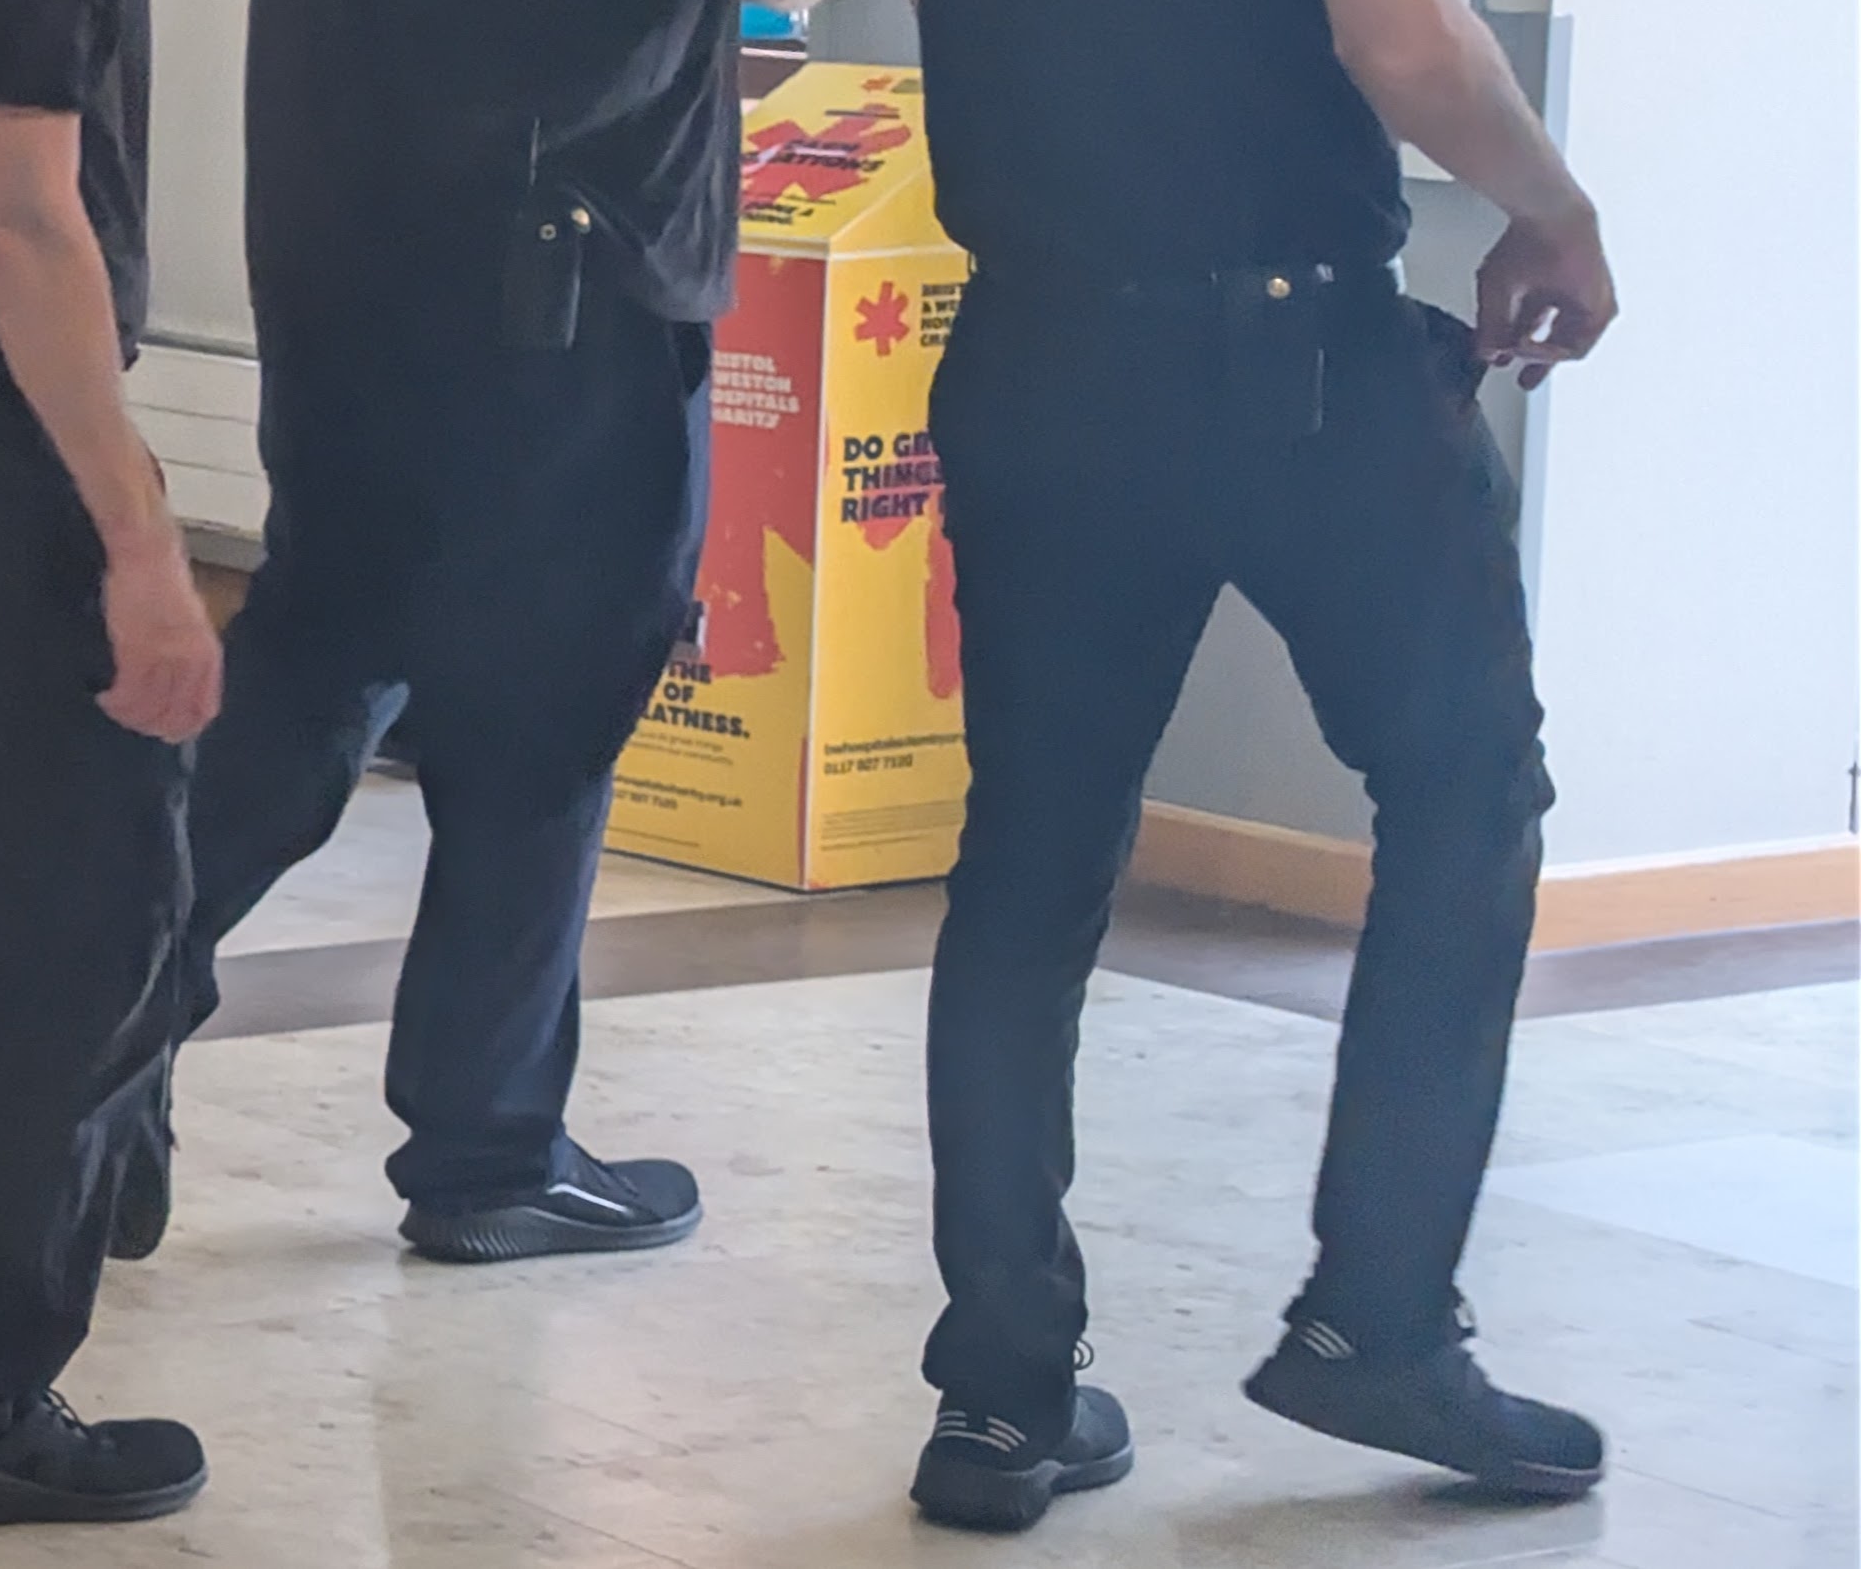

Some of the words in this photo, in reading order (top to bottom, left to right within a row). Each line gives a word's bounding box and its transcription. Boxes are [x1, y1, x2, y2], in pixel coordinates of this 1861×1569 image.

[935, 300, 958, 313] WE
[921, 317, 952, 331] HOS
[710, 389, 801, 413] OSPITALS
[711, 408, 782, 428] HARITY
[842, 434, 884, 462] DO
[893, 431, 934, 458] GR
[841, 492, 930, 523] RIGHT
[663, 681, 695, 703] OF
[643, 701, 751, 740] ATNESS.
